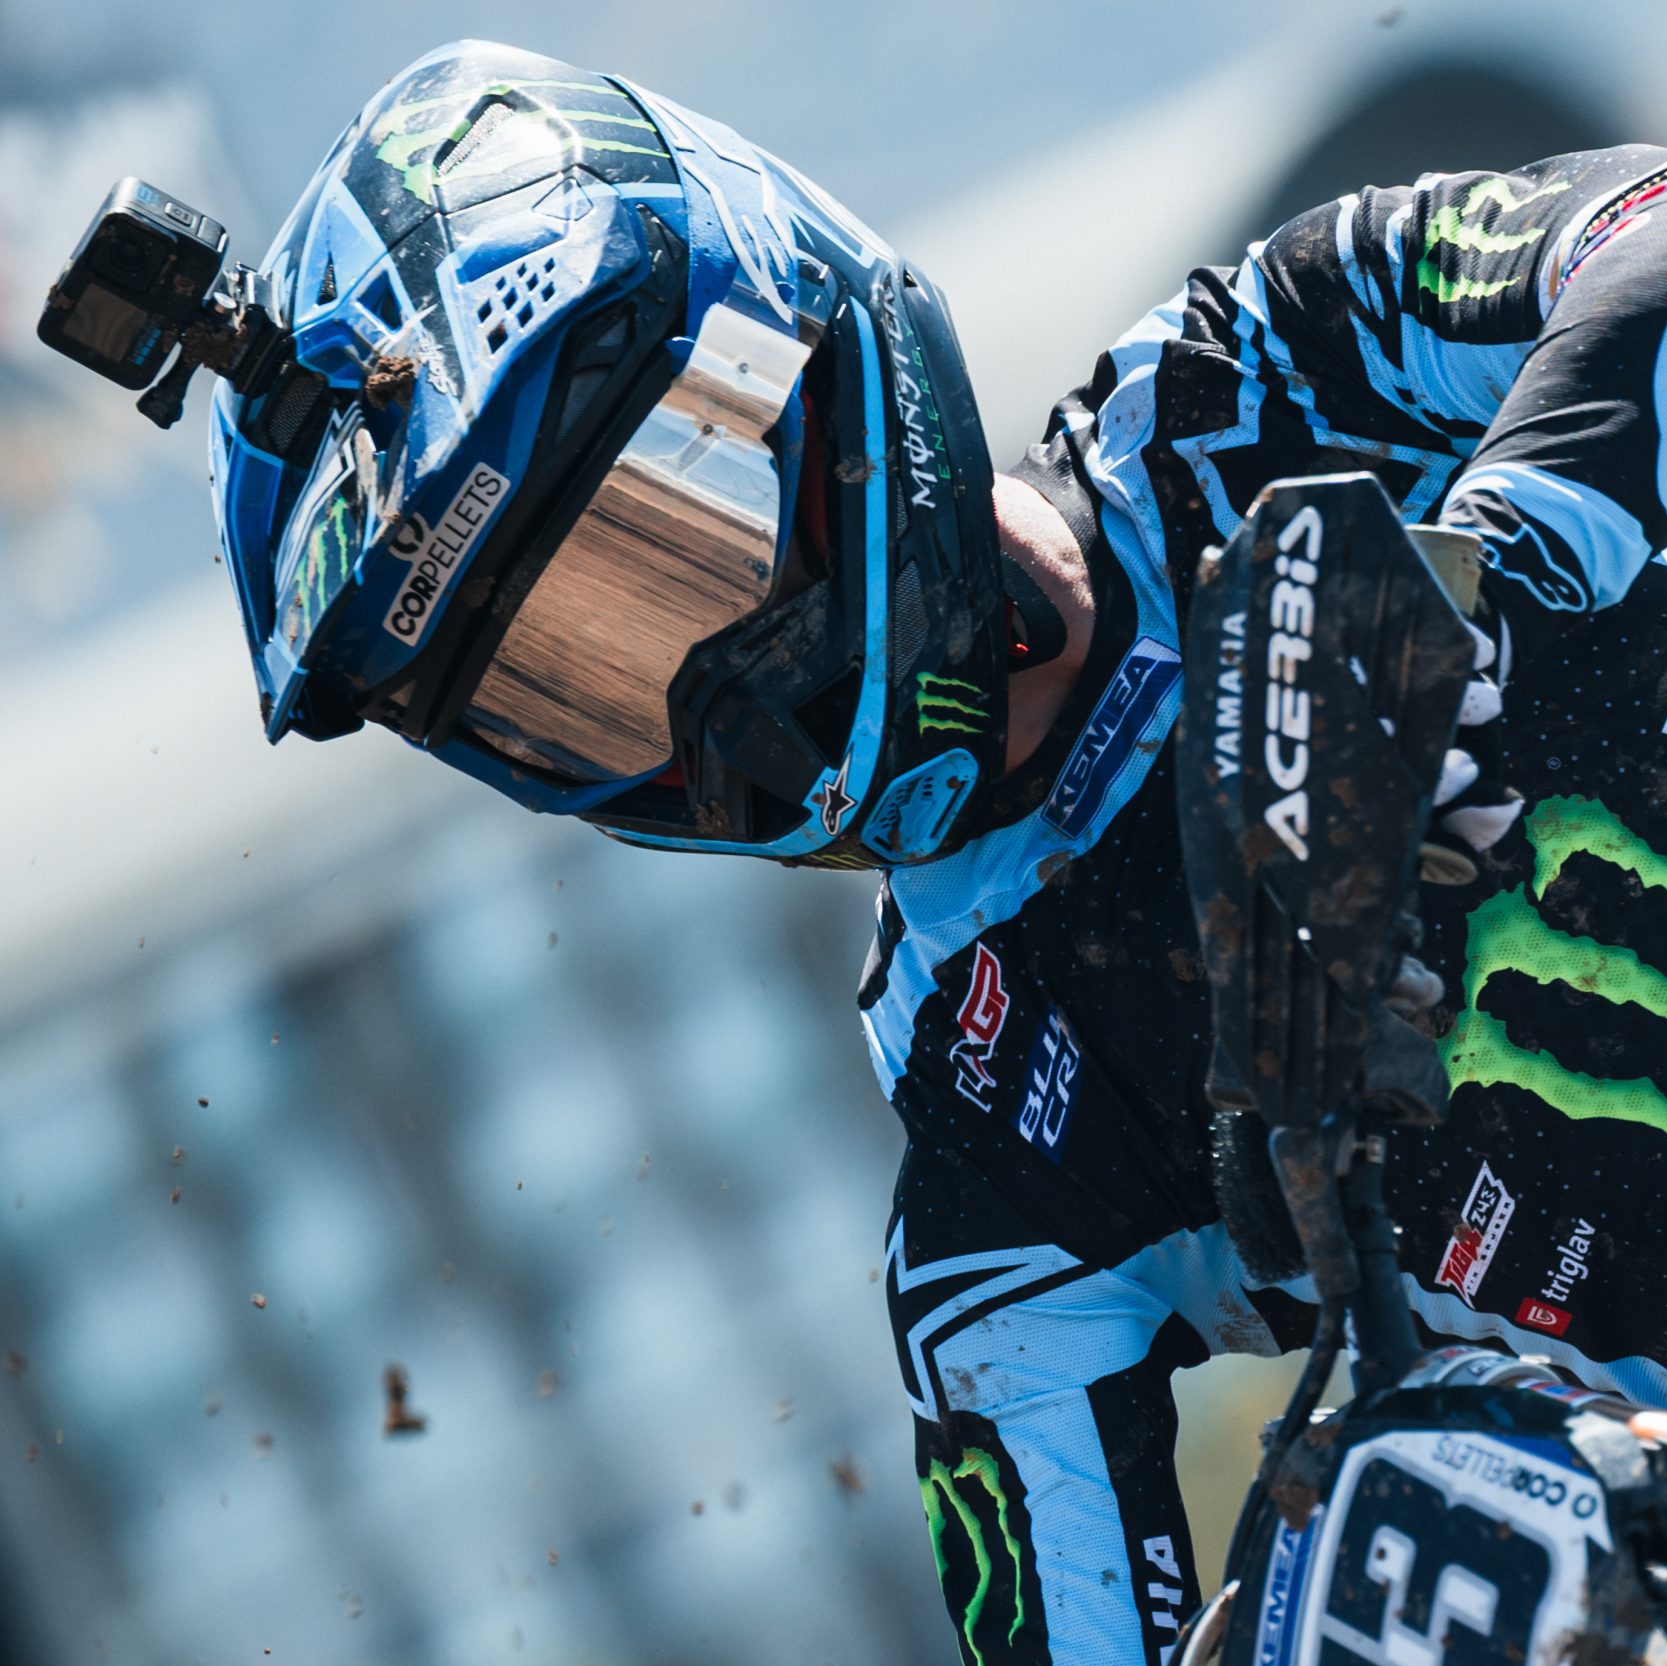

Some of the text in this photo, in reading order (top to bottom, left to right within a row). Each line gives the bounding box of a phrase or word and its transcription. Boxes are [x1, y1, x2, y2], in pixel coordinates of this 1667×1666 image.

[905, 325, 952, 481] ENERGY
[391, 470, 502, 637] CORPELLETS
[1213, 611, 1248, 780] YAMAHA
[1264, 505, 1324, 862] ACERBIS
[1541, 1218, 1597, 1303] triglav
